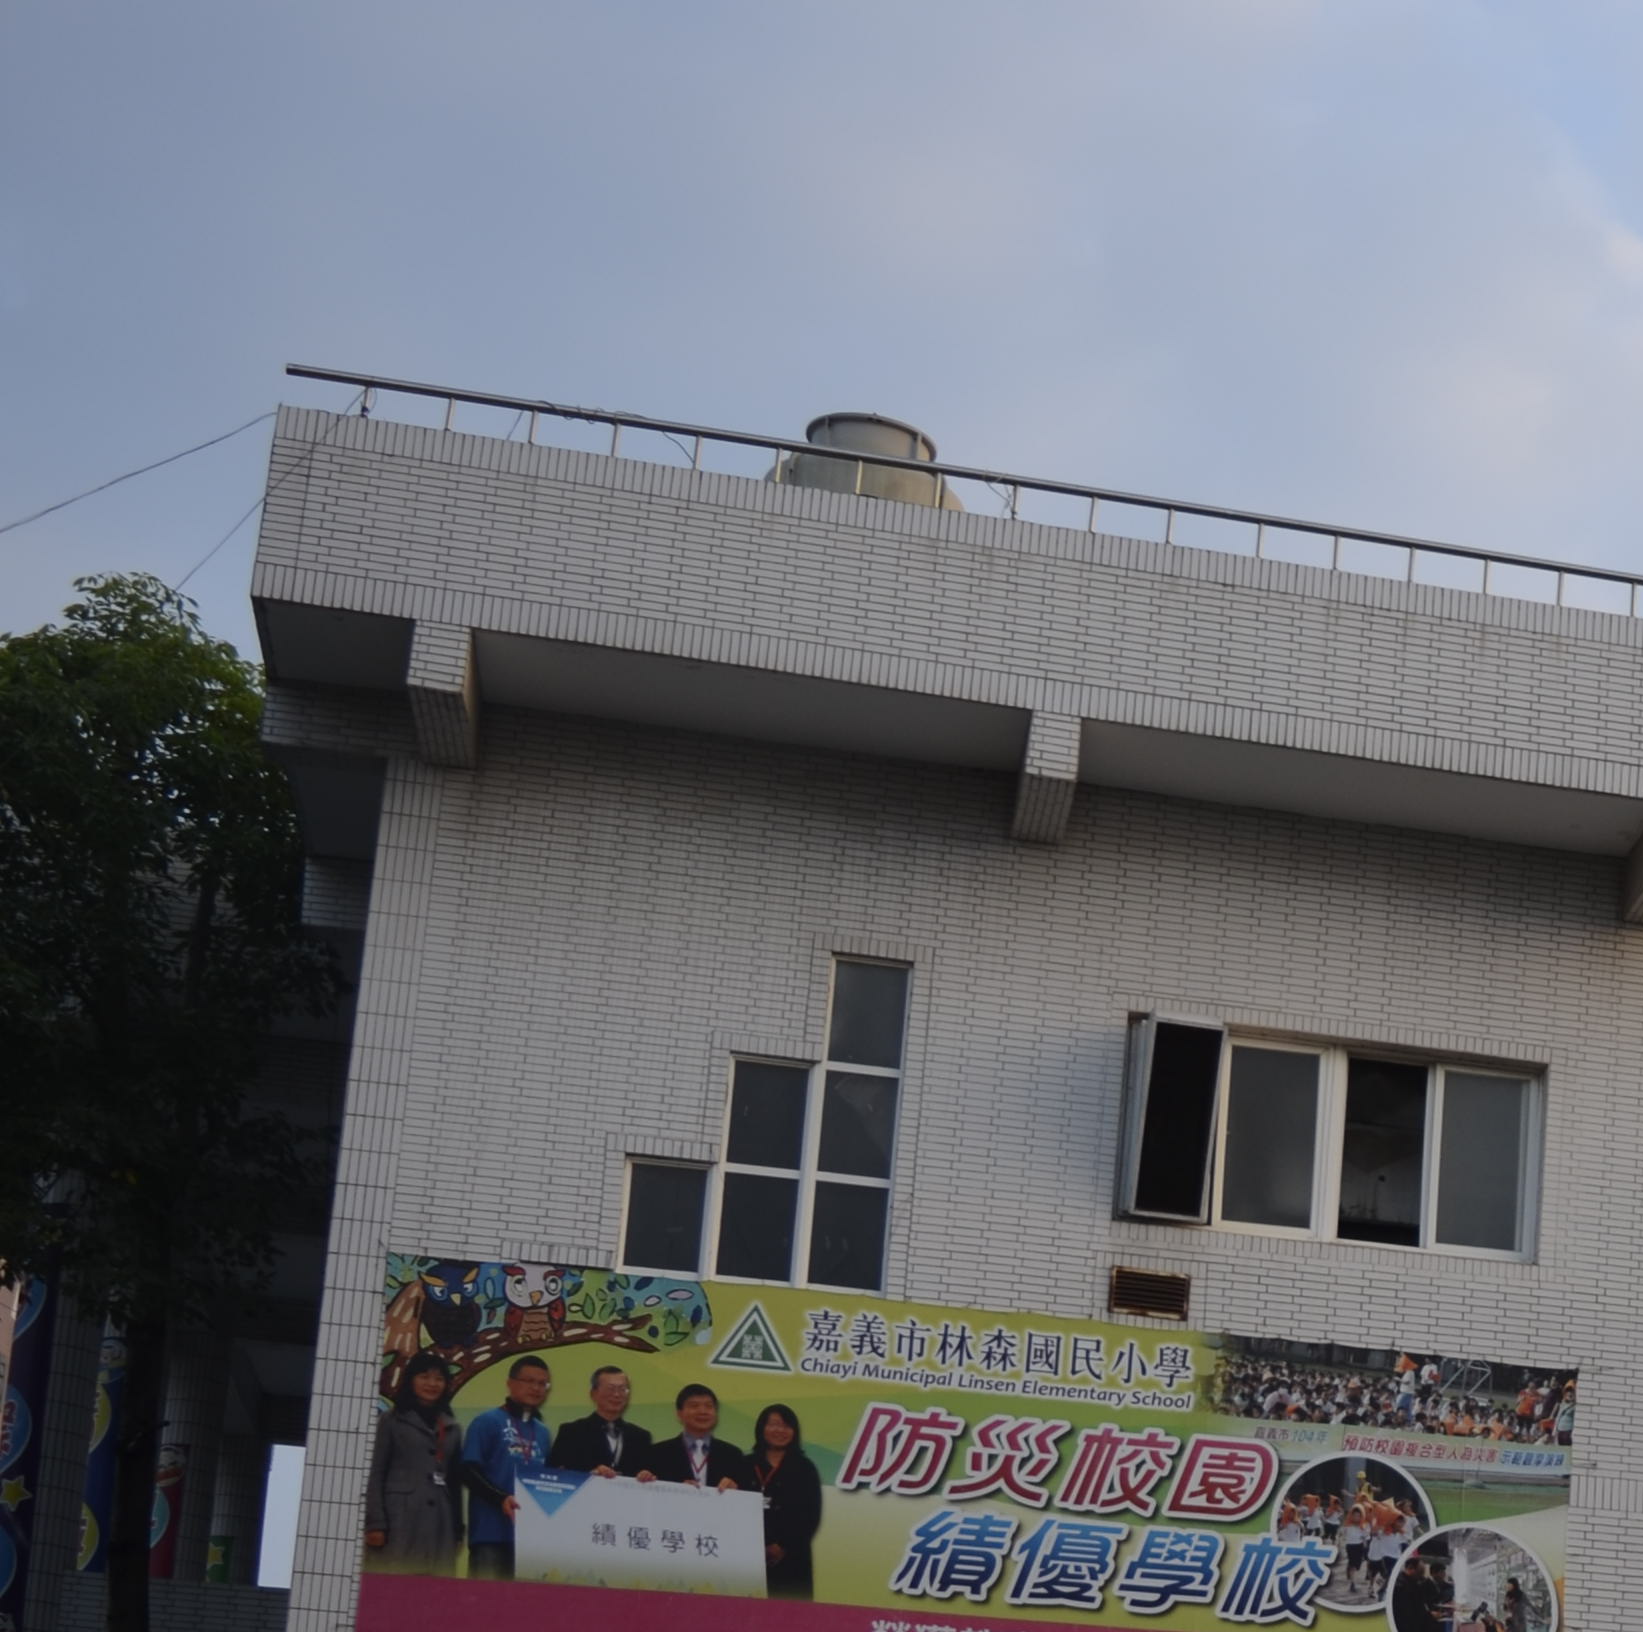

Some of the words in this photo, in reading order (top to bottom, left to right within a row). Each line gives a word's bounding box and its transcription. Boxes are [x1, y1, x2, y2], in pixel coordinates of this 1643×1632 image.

[801, 1357, 857, 1378] Chiayi
[862, 1363, 952, 1388] Municipal
[959, 1374, 1016, 1394] Linsen
[1022, 1381, 1125, 1407] Elementary
[1131, 1390, 1191, 1409] School
[805, 1310, 1192, 1388] 嘉義市林森國民小學
[838, 1403, 1280, 1522] 防災校園
[591, 1522, 719, 1558] 績優學校
[895, 1512, 1331, 1626] 績優學校
